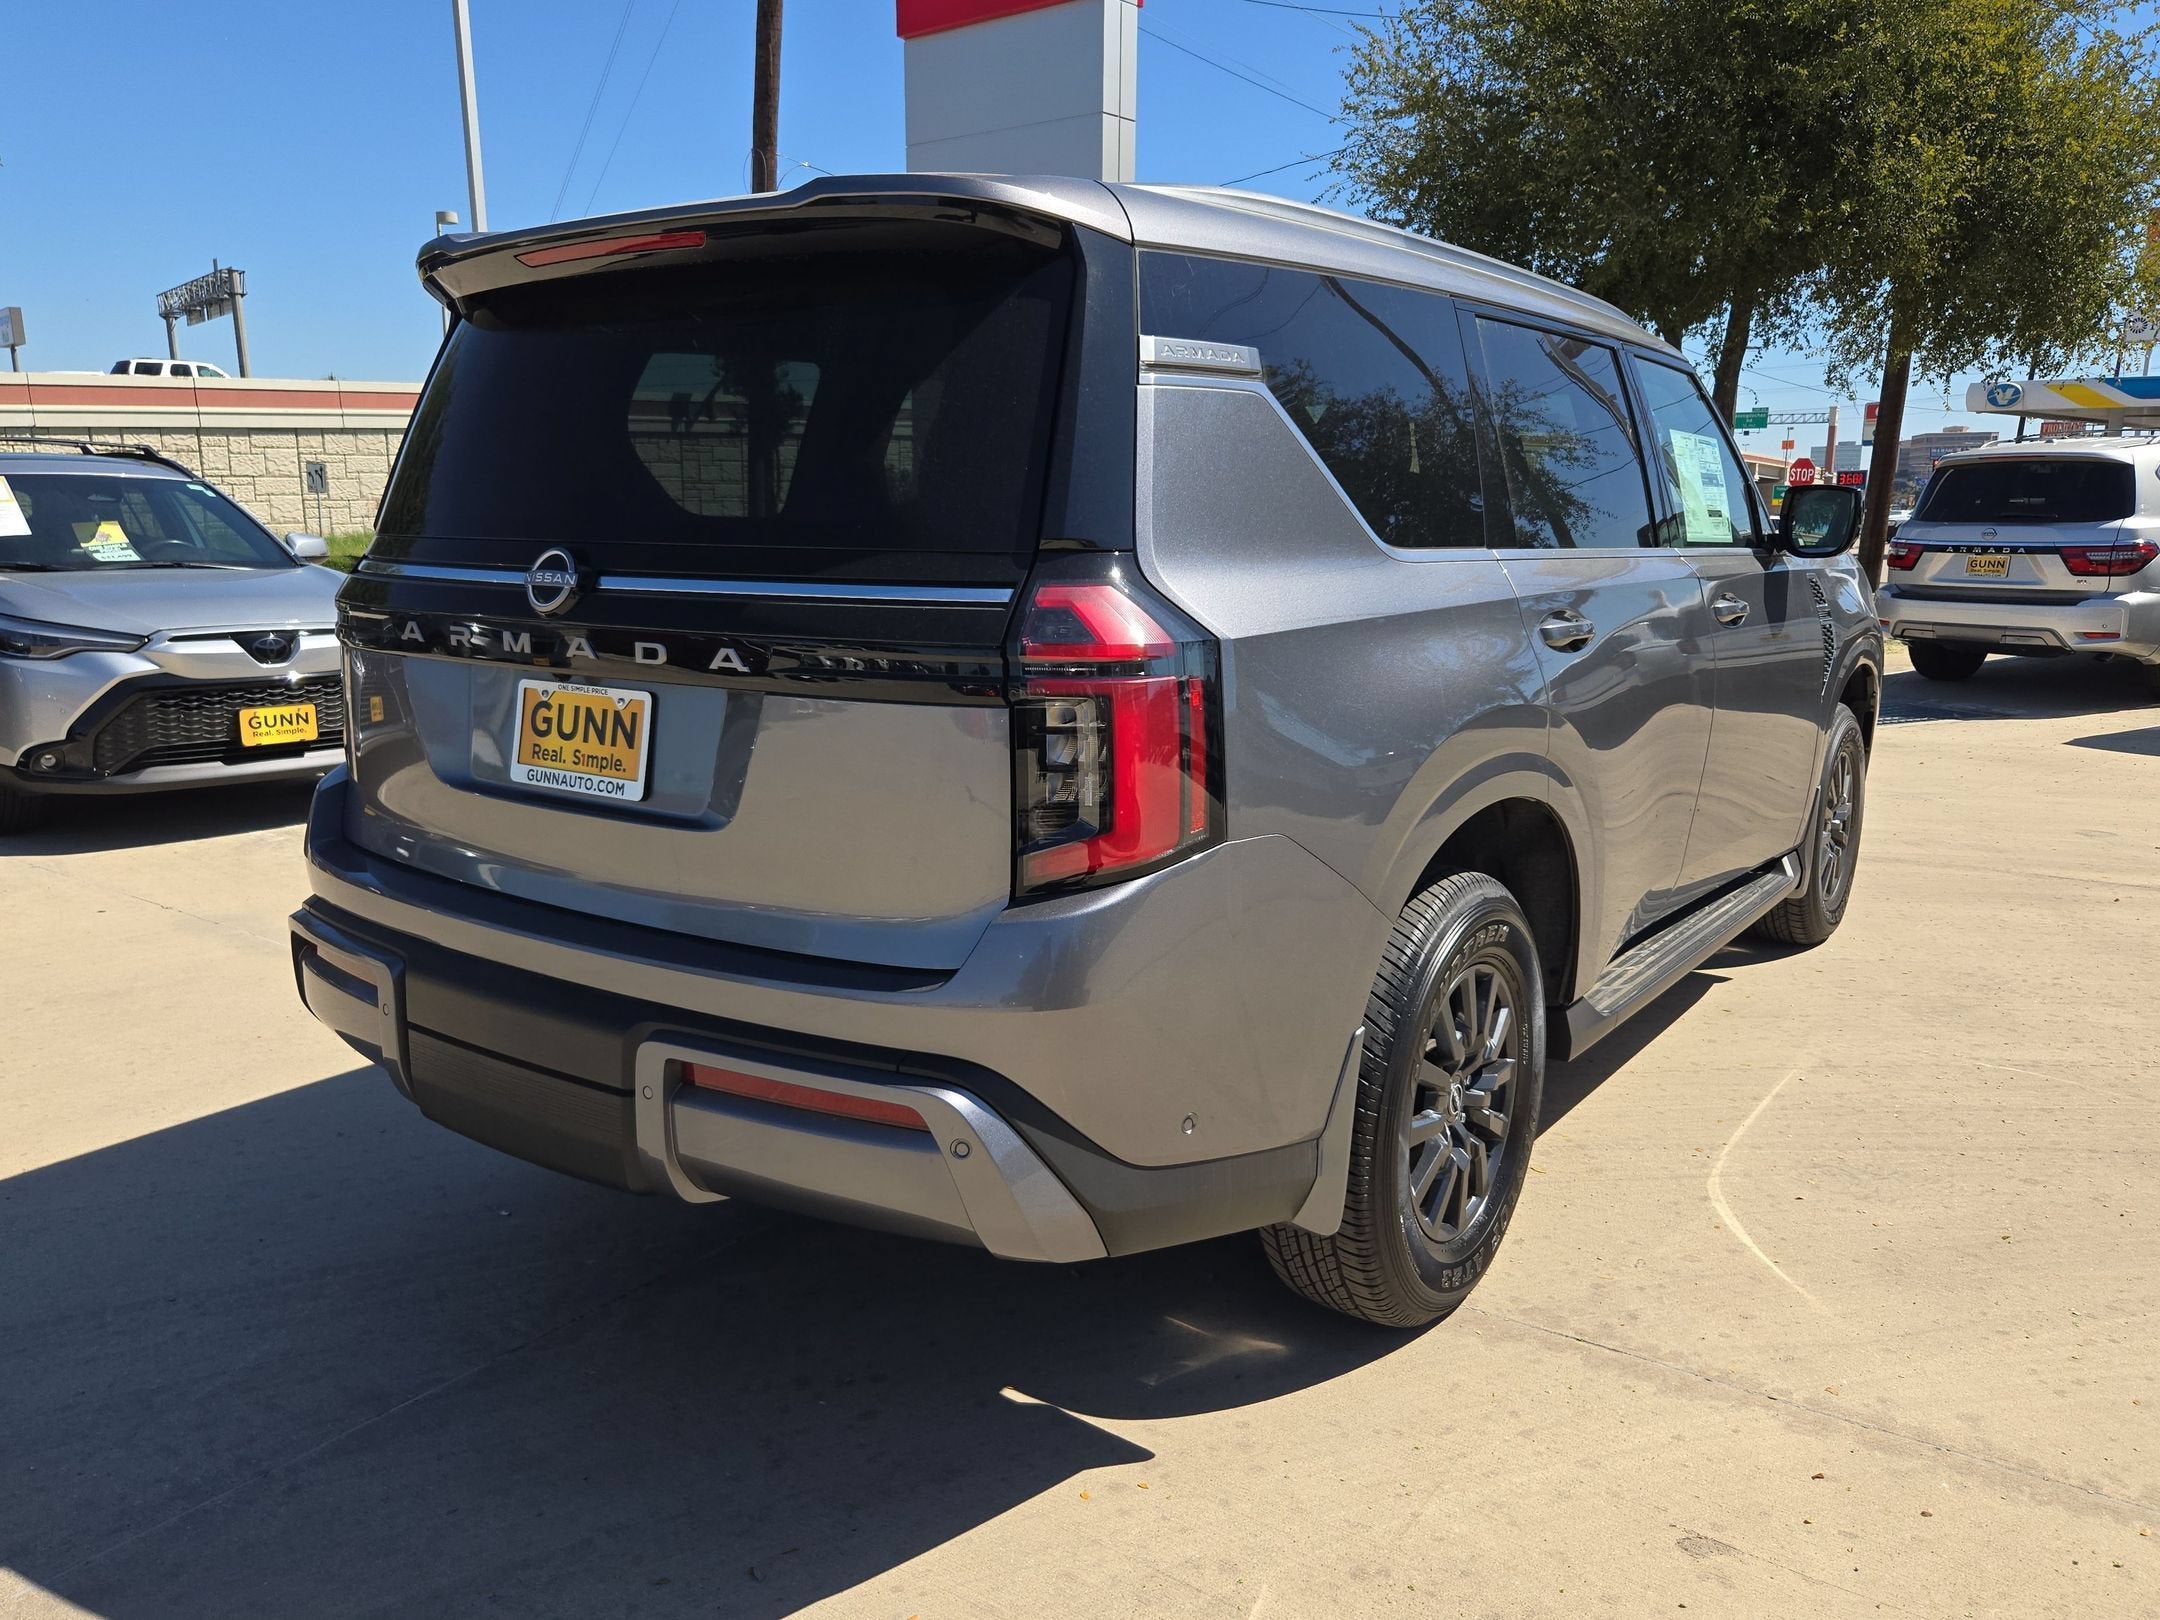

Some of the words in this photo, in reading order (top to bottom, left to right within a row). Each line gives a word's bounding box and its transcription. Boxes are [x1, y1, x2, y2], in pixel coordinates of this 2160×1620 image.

[1160, 344, 1246, 363] ARMADA
[1789, 468, 1815, 481] STOP
[1946, 546, 2026, 554] ARMADA
[1970, 559, 2006, 568] GUNN
[525, 572, 578, 585] NISSAN
[400, 620, 751, 673] ARMADA
[558, 684, 570, 692] ONE
[570, 685, 592, 694] SIMPLE
[591, 687, 609, 696] PRICE
[248, 711, 310, 729] GUNN
[531, 700, 638, 750] GUNN
[253, 730, 275, 738] Real.
[532, 743, 566, 764] Real.
[526, 768, 626, 796] GUNNAUTO.COM
